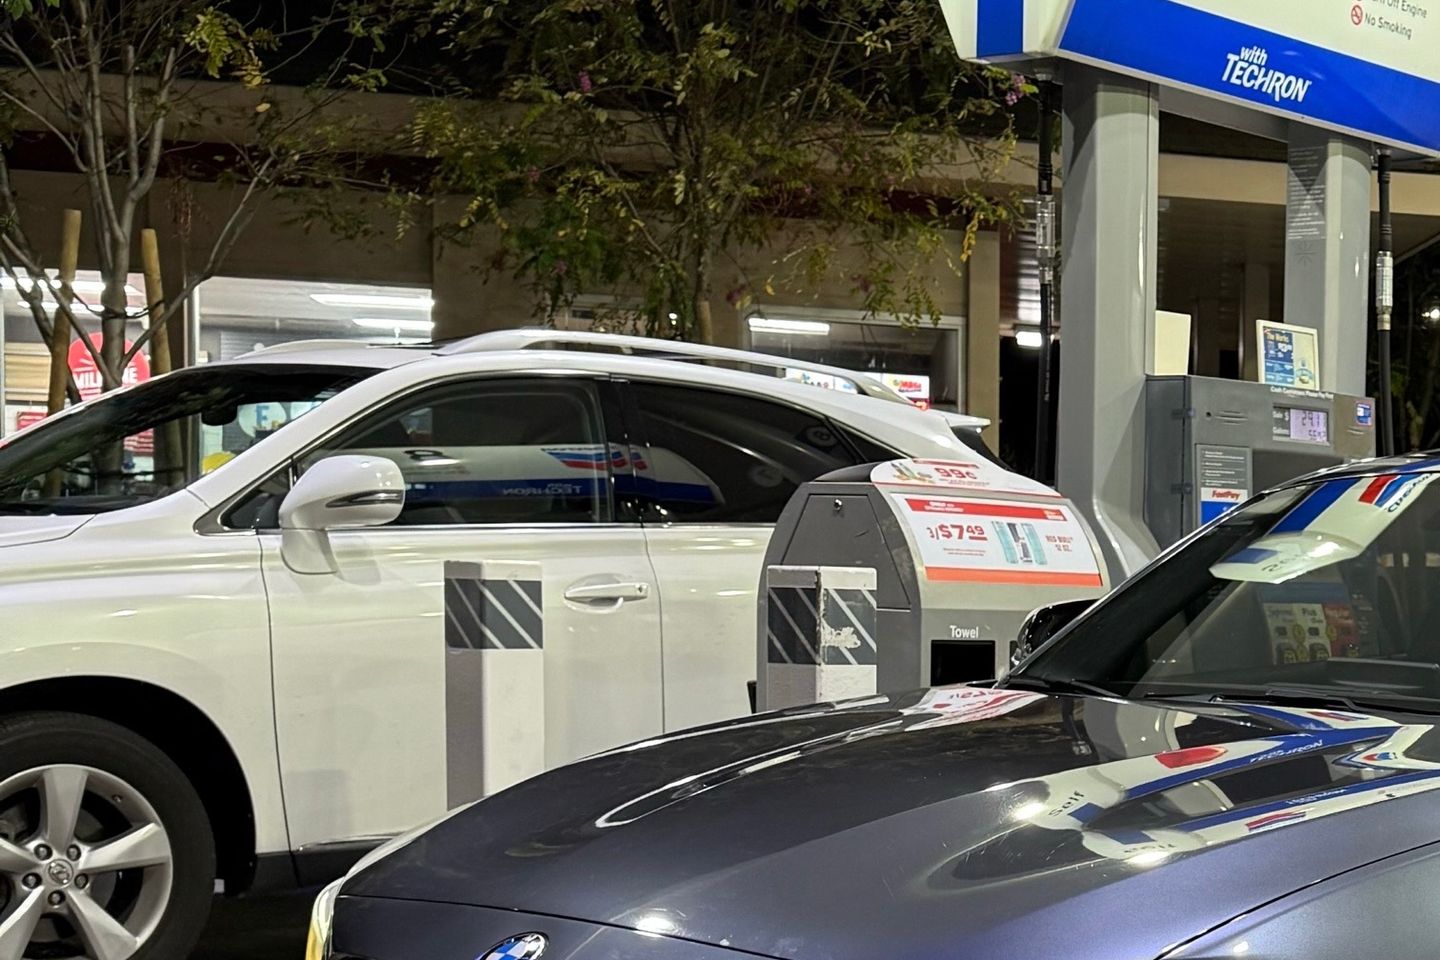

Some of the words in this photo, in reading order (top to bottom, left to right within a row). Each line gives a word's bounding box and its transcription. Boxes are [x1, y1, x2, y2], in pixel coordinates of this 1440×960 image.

[1365, 13, 1376, 26] No
[1378, 16, 1412, 40] Smoking
[1241, 46, 1268, 66] with
[1222, 53, 1309, 102] TECHRON
[1212, 490, 1240, 500] FastPay
[949, 625, 979, 639] Towel
